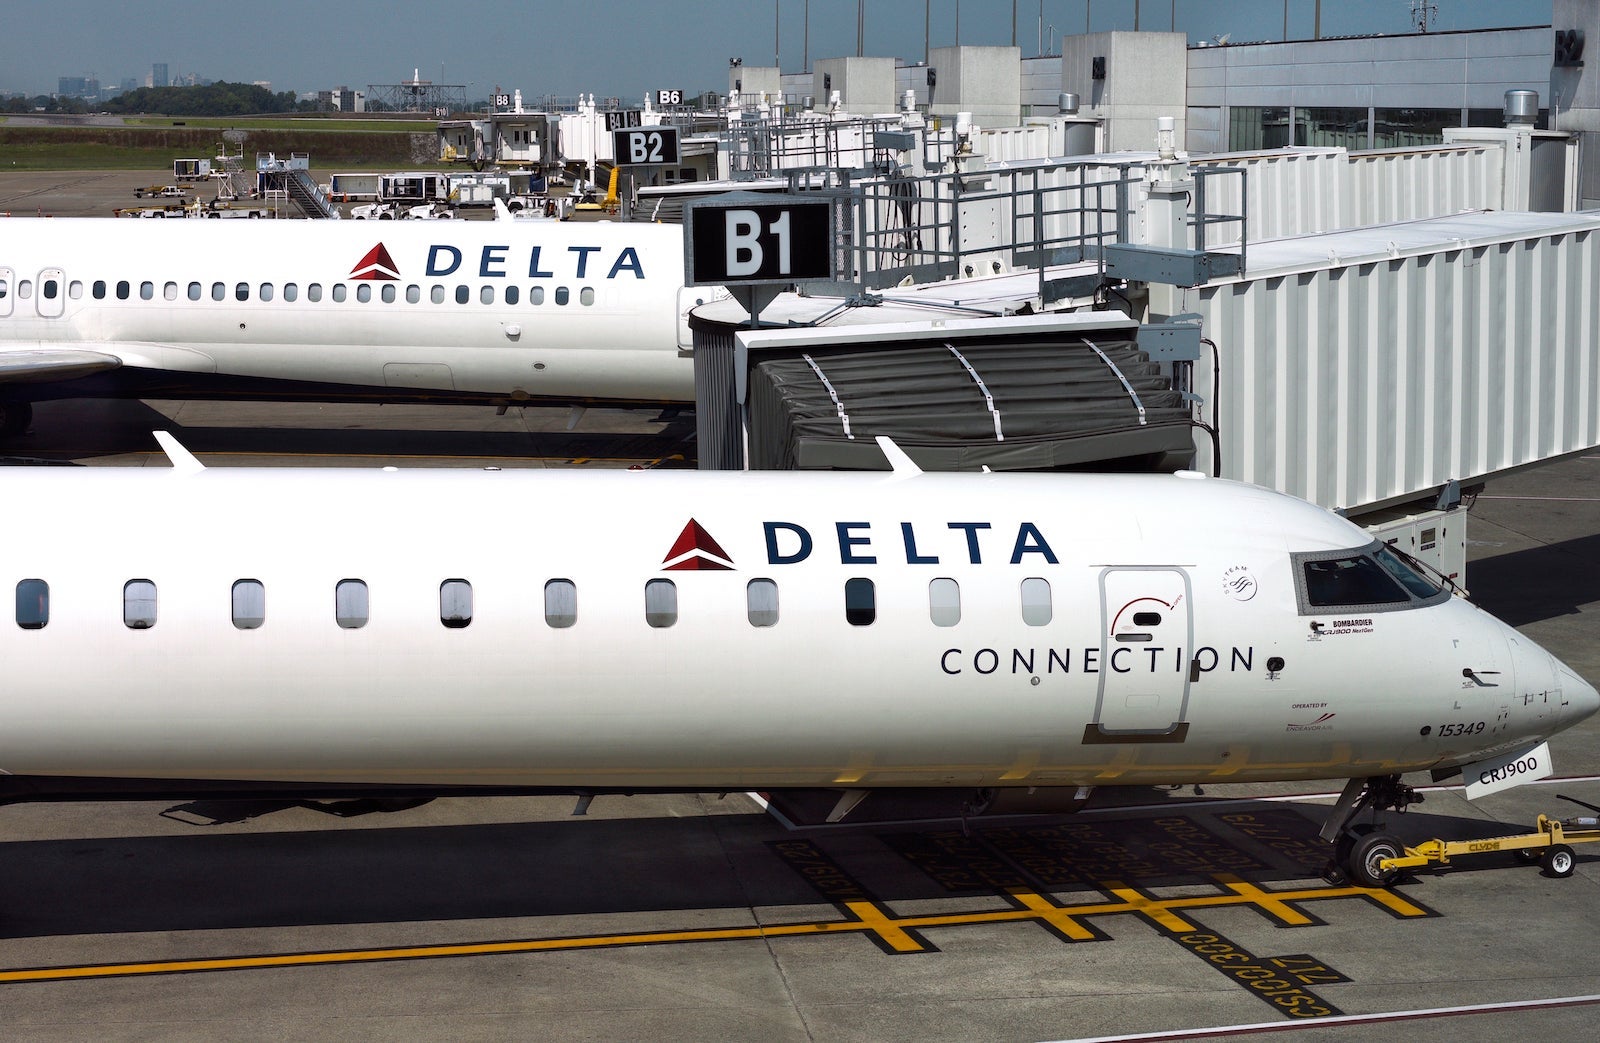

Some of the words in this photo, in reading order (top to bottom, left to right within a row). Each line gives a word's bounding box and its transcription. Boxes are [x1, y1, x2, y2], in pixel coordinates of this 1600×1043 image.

[496, 95, 509, 106] B8
[659, 90, 680, 105] B6
[609, 113, 621, 130] B4
[629, 131, 664, 163] B2
[725, 209, 791, 277] B1
[426, 244, 646, 280] DELTA
[762, 521, 1060, 565] DELTA
[1223, 565, 1248, 595] SKYTEAM
[1332, 619, 1373, 628] BOMBARDIER
[940, 647, 1254, 676] CONNECTION
[1438, 721, 1486, 738] 15349
[1479, 757, 1538, 786] CRJ900
[1469, 841, 1500, 852] CLYDE
[1180, 933, 1332, 1018] CS100/300
[1270, 957, 1340, 985] 717
